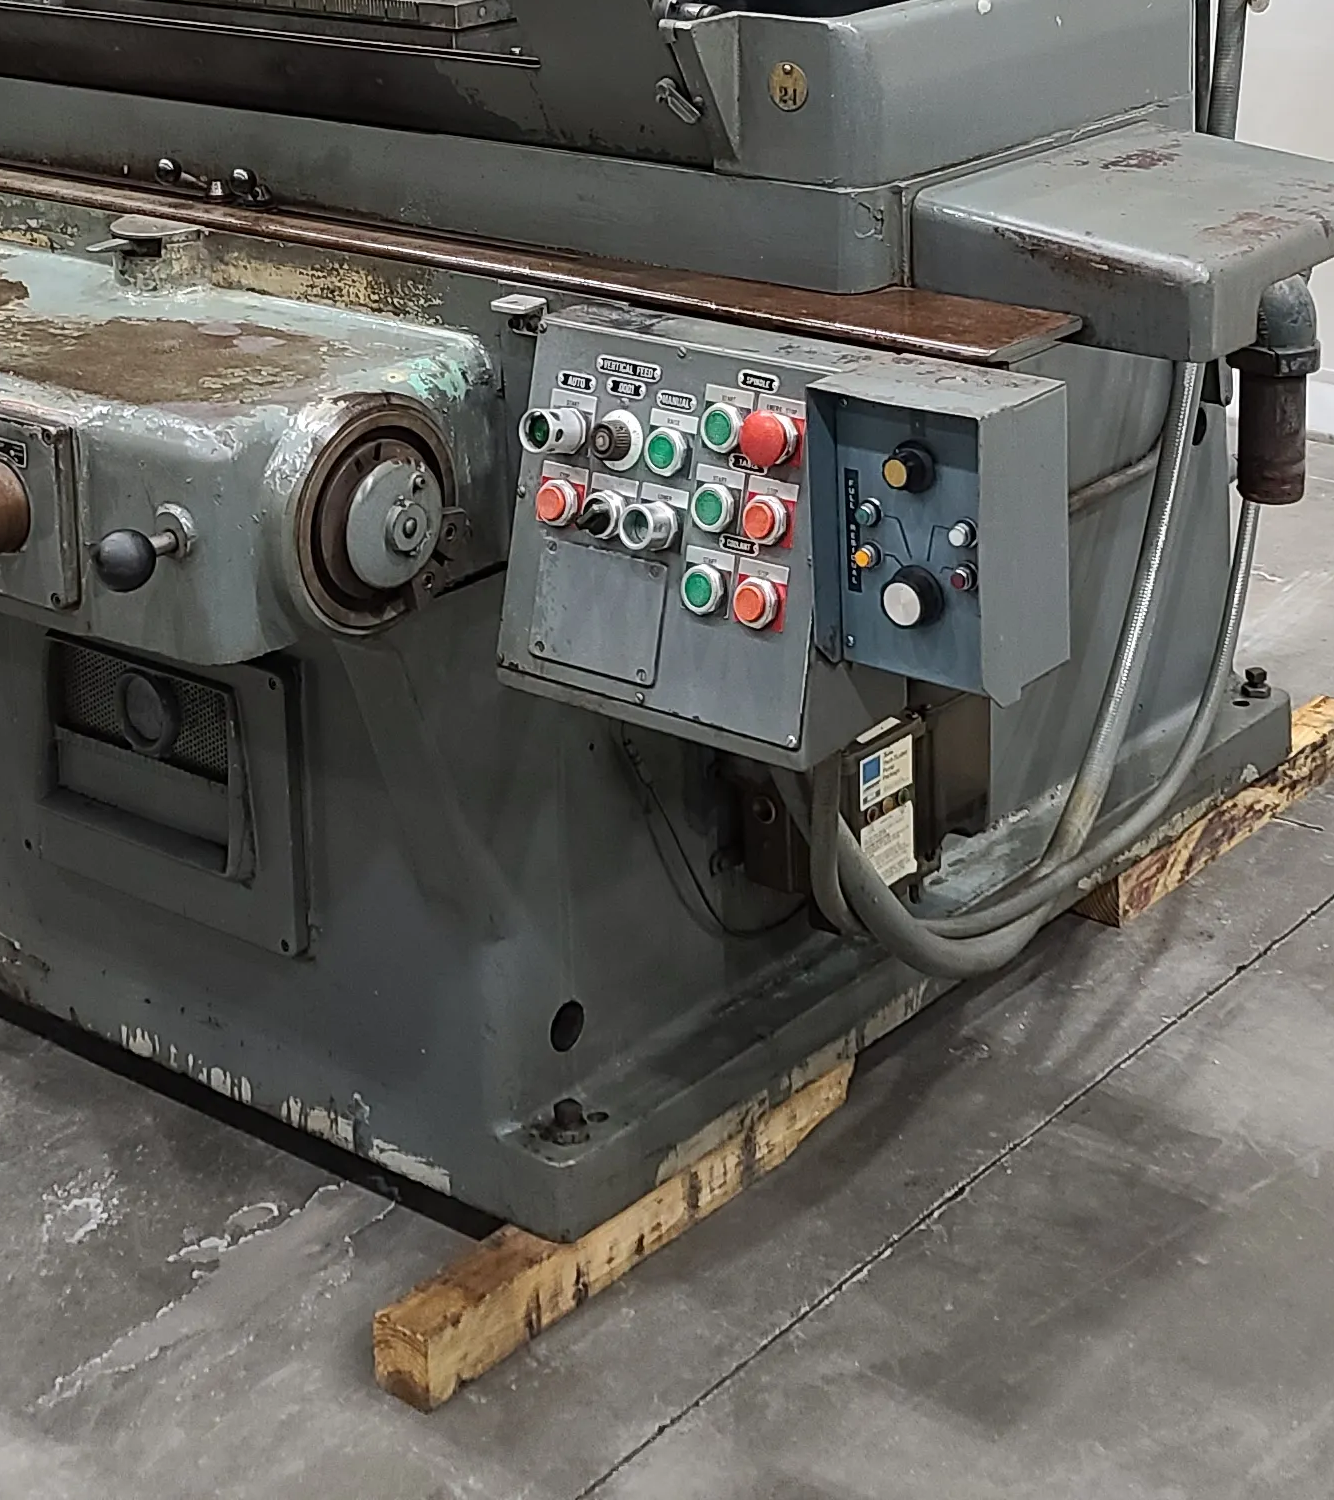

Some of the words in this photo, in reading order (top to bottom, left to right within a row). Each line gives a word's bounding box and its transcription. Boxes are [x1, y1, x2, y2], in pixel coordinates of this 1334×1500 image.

[603, 359, 634, 375] VERTICAL
[636, 366, 653, 378] FEED
[567, 376, 586, 388] AUTO
[746, 376, 771, 389] SPINDLE
[661, 394, 690, 409] MANUAL
[727, 539, 751, 551] COOLANT
